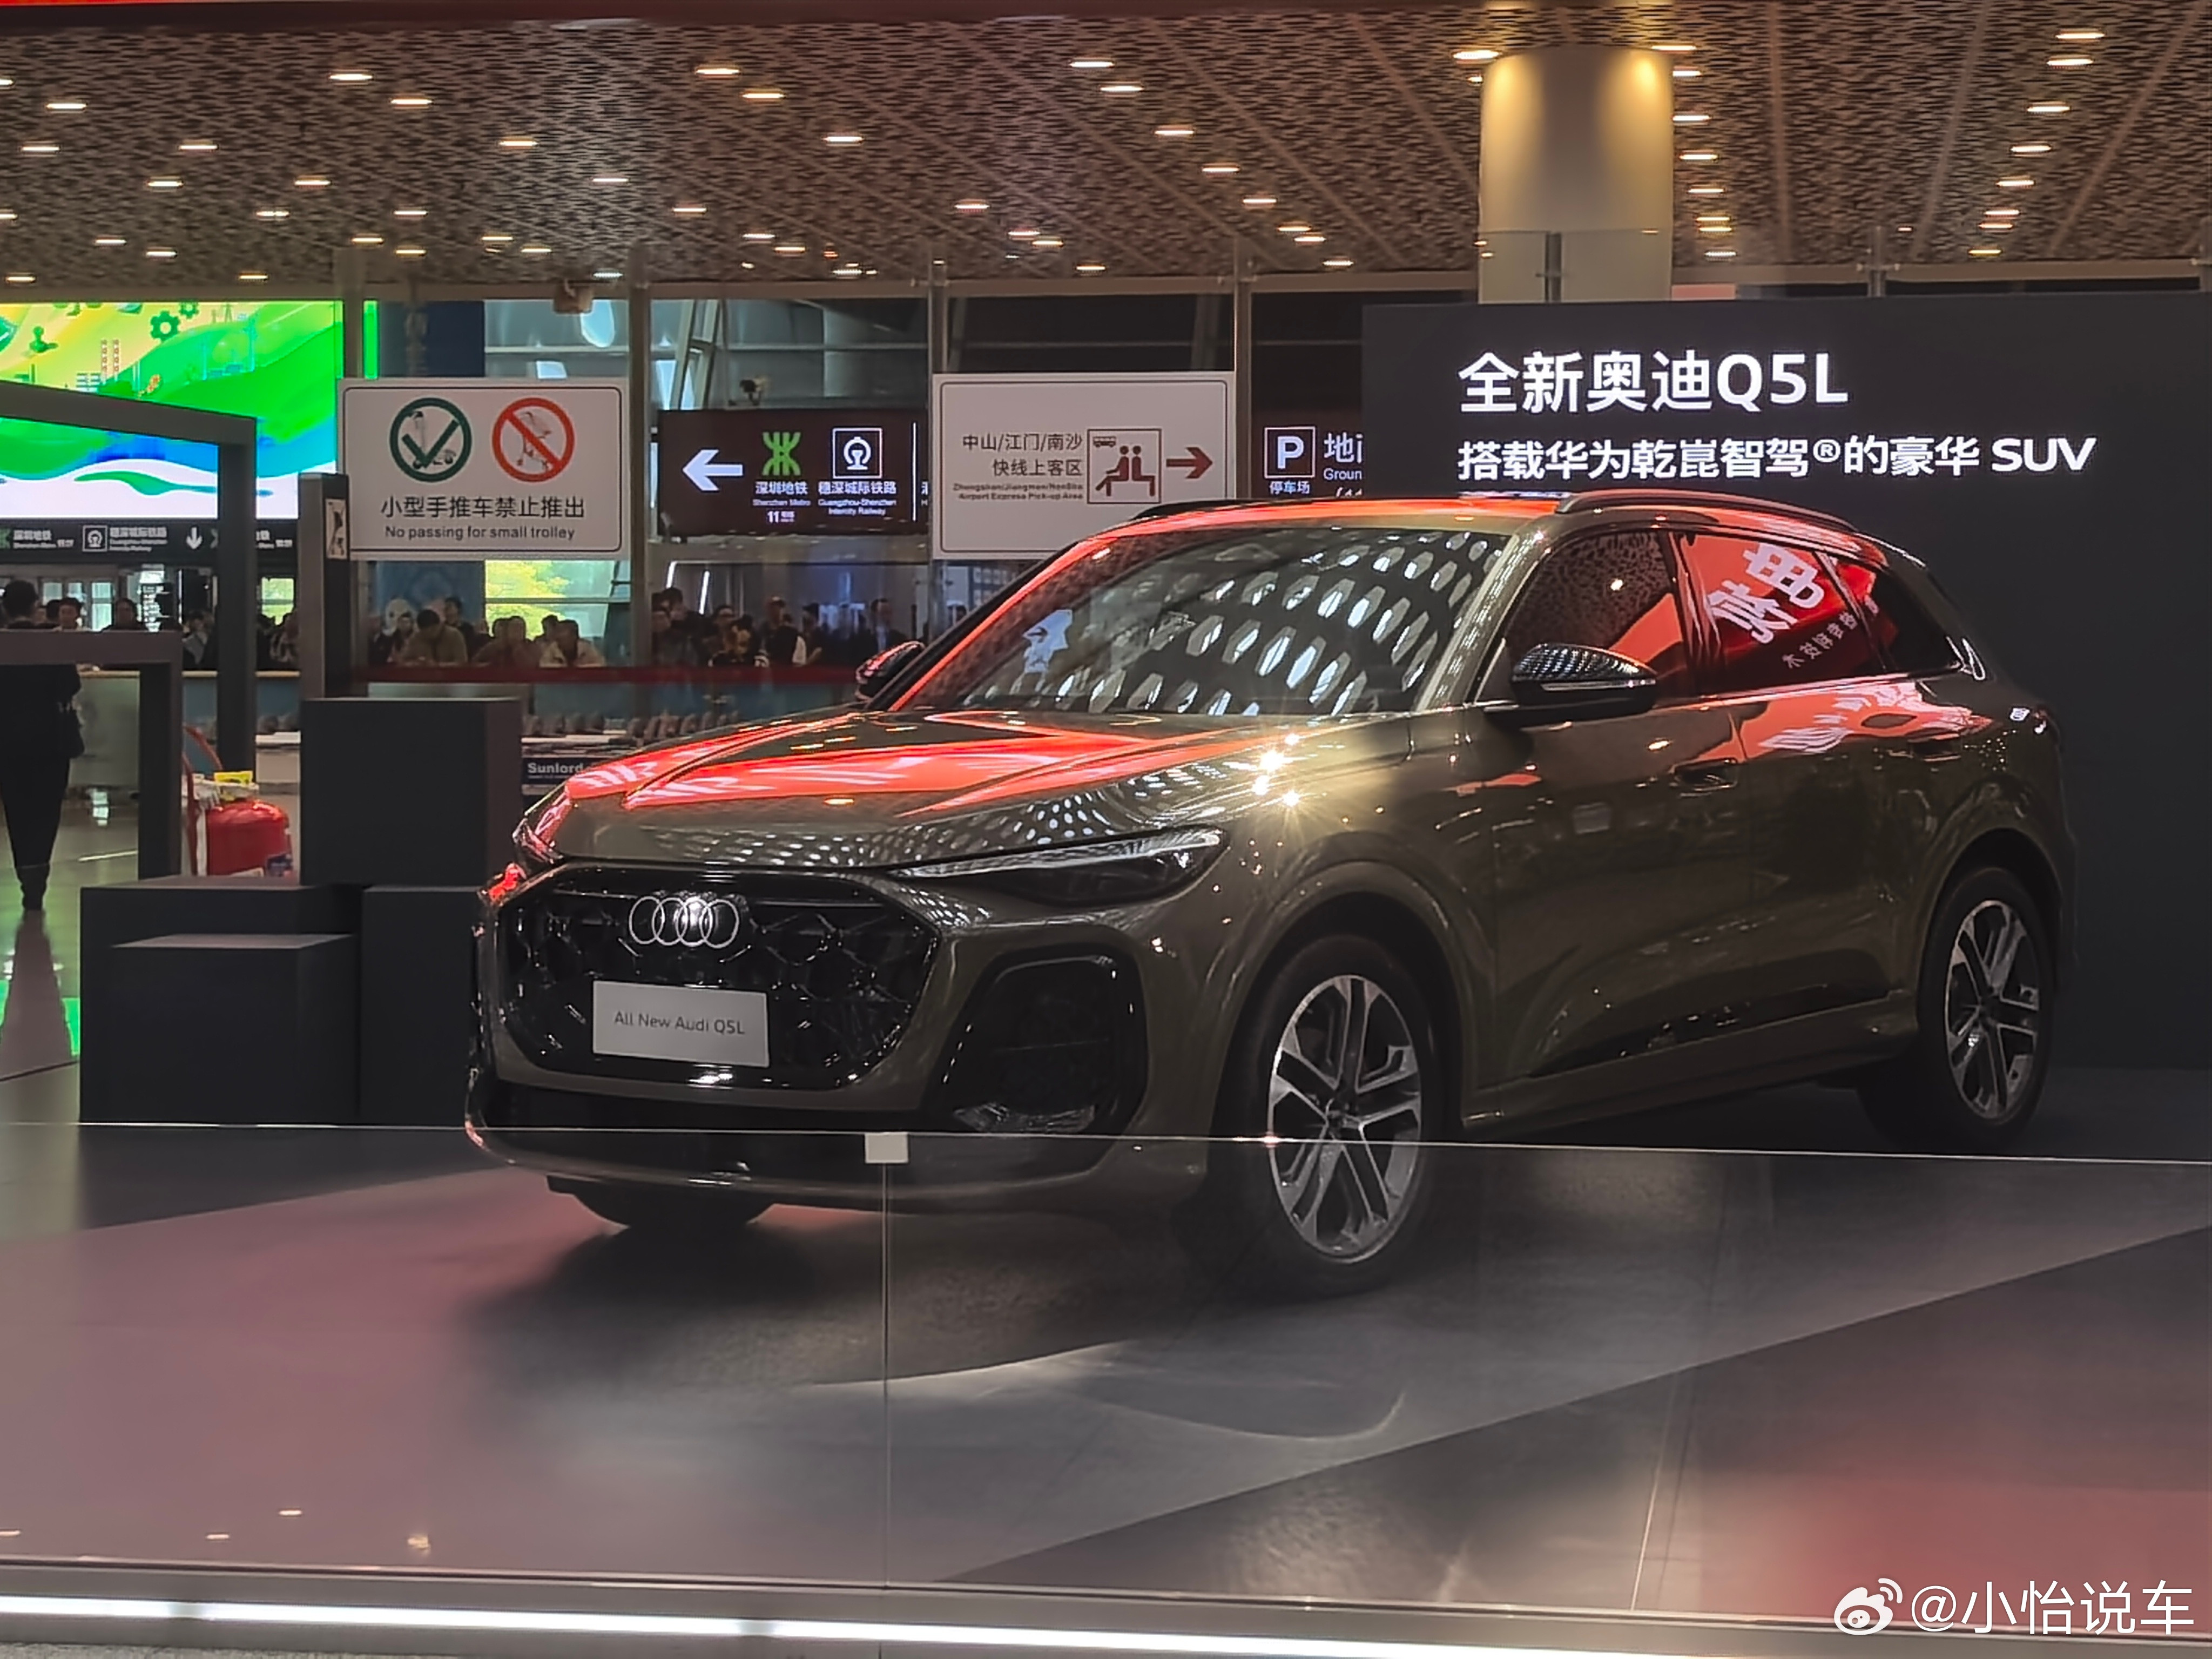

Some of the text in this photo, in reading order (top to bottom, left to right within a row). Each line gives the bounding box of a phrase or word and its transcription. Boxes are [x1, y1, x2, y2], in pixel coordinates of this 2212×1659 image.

[1459, 350, 1849, 414] 全新奥迪Q5L
[962, 433, 1083, 451] 中山/江门/南沙
[1277, 436, 1304, 469] P
[1991, 438, 2096, 471] SUV
[993, 458, 1083, 476] 快线上客区
[755, 481, 808, 495] 深圳地铁
[1270, 480, 1310, 495] 停车场
[381, 495, 584, 518] 小型手推车禁止推出
[385, 525, 575, 541] No passing for small trolley
[528, 762, 584, 774] Sunlord
[614, 1011, 745, 1035] All New Audi Q5L
